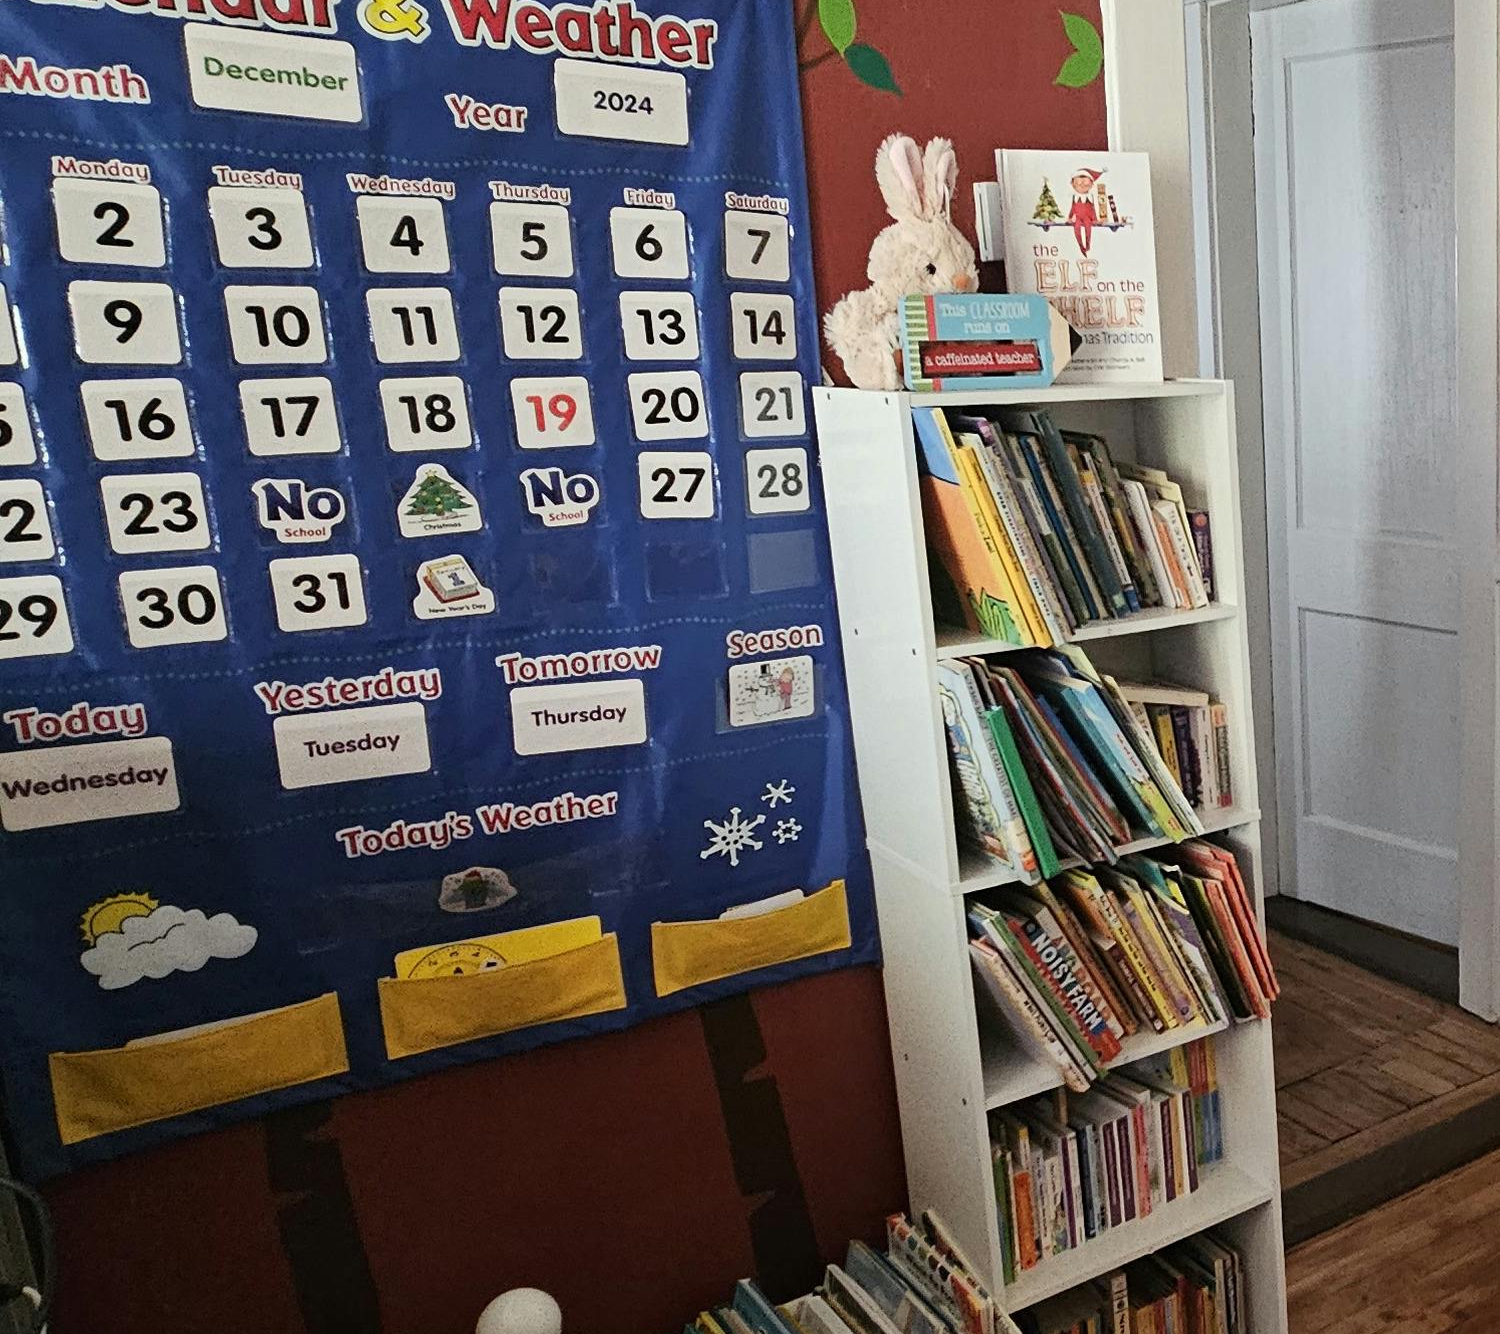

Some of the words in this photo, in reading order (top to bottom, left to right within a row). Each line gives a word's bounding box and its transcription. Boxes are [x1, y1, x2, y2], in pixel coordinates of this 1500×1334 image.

[0, 55, 151, 102] Month
[203, 54, 349, 93] December
[446, 93, 528, 133] Year
[593, 90, 654, 116] 2024
[53, 156, 149, 181] Monday
[214, 166, 303, 190] Tuesday
[347, 173, 456, 199] Wednesday
[491, 181, 571, 205] Thursday
[625, 188, 674, 209] Friday
[726, 192, 790, 213] Saturday
[94, 201, 131, 249] 2
[247, 204, 282, 252] 3
[389, 214, 425, 259] 4
[519, 221, 549, 261] 5
[634, 223, 664, 262] 6
[746, 228, 772, 266] 7
[1033, 244, 1058, 256] the
[1034, 259, 1099, 293] ELF
[1097, 281, 1115, 292] on
[1120, 279, 1144, 292] the
[103, 298, 142, 345] 9
[244, 303, 311, 350] 10
[390, 304, 435, 347] 11
[516, 303, 570, 345] 12
[635, 307, 688, 346] 13
[742, 307, 788, 346] 14
[939, 303, 966, 317] This
[970, 302, 1030, 318] CLASSROOM
[963, 322, 992, 334] runs
[995, 322, 1010, 333] on
[935, 353, 993, 366] caffeinated
[995, 352, 1035, 365] teacher
[105, 397, 177, 443] 16
[260, 394, 321, 439] 17
[398, 393, 457, 434] 18
[525, 393, 578, 433] 19
[639, 386, 701, 425] 20
[755, 386, 795, 422] 21
[261, 482, 342, 521] No
[527, 471, 594, 507] No
[650, 466, 707, 504] 27
[757, 463, 803, 498] 28
[118, 491, 199, 536] 23
[284, 527, 326, 538] School
[424, 521, 462, 530] Christmas
[549, 510, 584, 521] School
[136, 585, 217, 630] 30
[291, 572, 352, 615] 31
[727, 623, 823, 658] Season
[496, 643, 662, 684] Tomorrow
[255, 665, 442, 715] Yesterday
[9, 702, 146, 743] Today
[531, 703, 627, 731] Thursday
[303, 731, 401, 760] Tuesday
[2, 762, 169, 801] Wednesday
[340, 810, 473, 859] Today's
[482, 791, 619, 833] Weather
[1031, 933, 1076, 991] NOISY
[1067, 986, 1105, 1030] FARM
